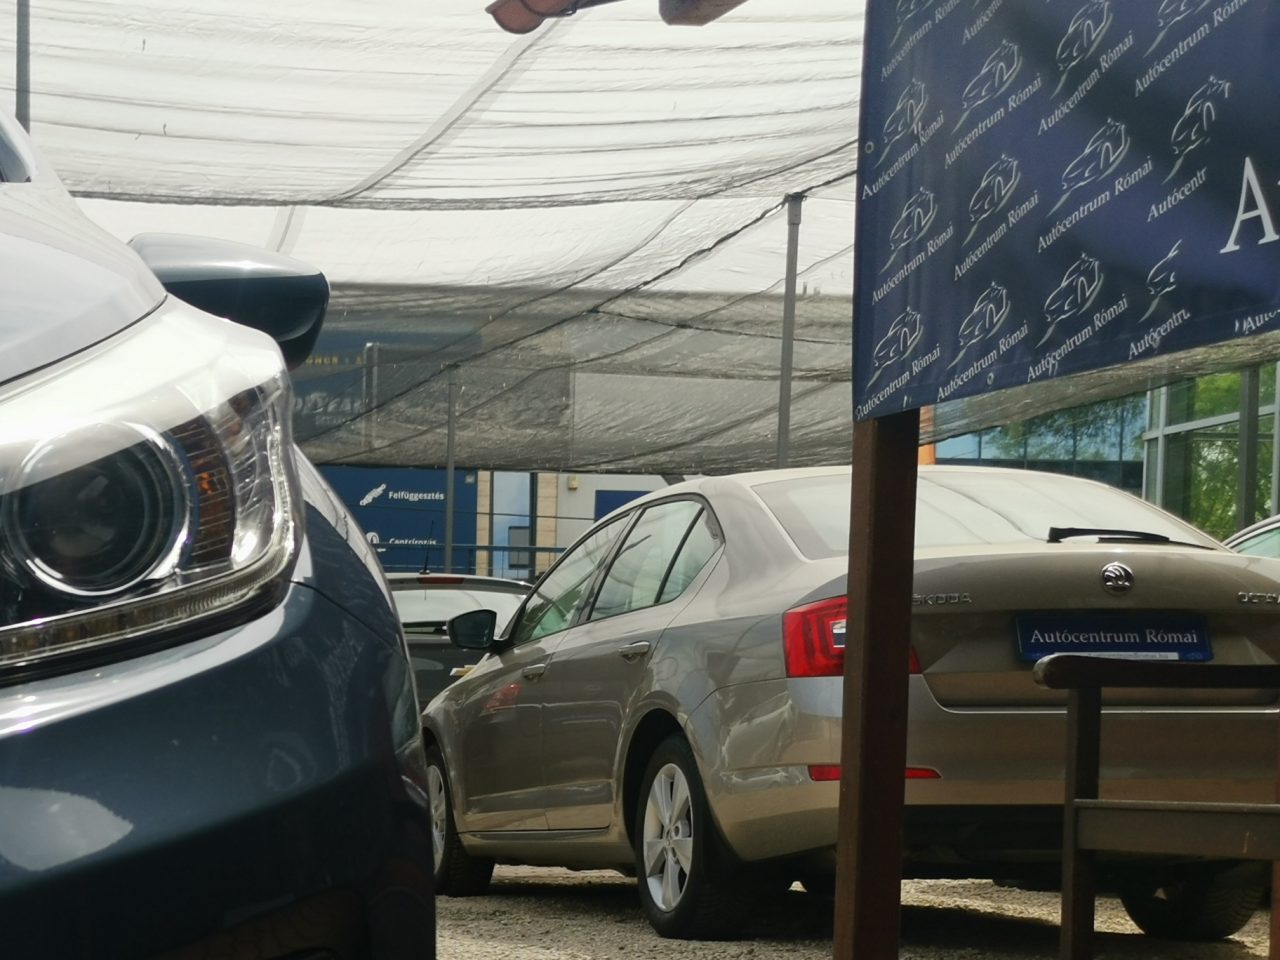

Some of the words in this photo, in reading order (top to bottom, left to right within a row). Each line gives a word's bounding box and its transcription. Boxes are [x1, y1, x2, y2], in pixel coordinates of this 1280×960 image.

[1037, 68, 1100, 135] Autócentrum
[1100, 30, 1133, 72] Római
[1134, 23, 1210, 97] Autócentrum
[944, 107, 1005, 169] Autócentrum
[1008, 73, 1042, 112] Római
[862, 143, 919, 199] Autócentrum
[1038, 191, 1110, 253] Autócentrum
[1114, 156, 1154, 196] Római
[872, 254, 926, 306] Autócentrum
[927, 221, 954, 256] Római
[954, 222, 1007, 281] Autócentrum
[1007, 190, 1039, 228] Római
[911, 344, 940, 376] Római
[936, 352, 998, 403] Autócentrum
[999, 320, 1029, 355] Római
[1027, 327, 1093, 383] Autócentrum
[1093, 293, 1128, 331] Római
[388, 491, 444, 502] Felfüggesztés
[1031, 629, 1140, 643] Autócentrum
[1145, 628, 1197, 643] Római
